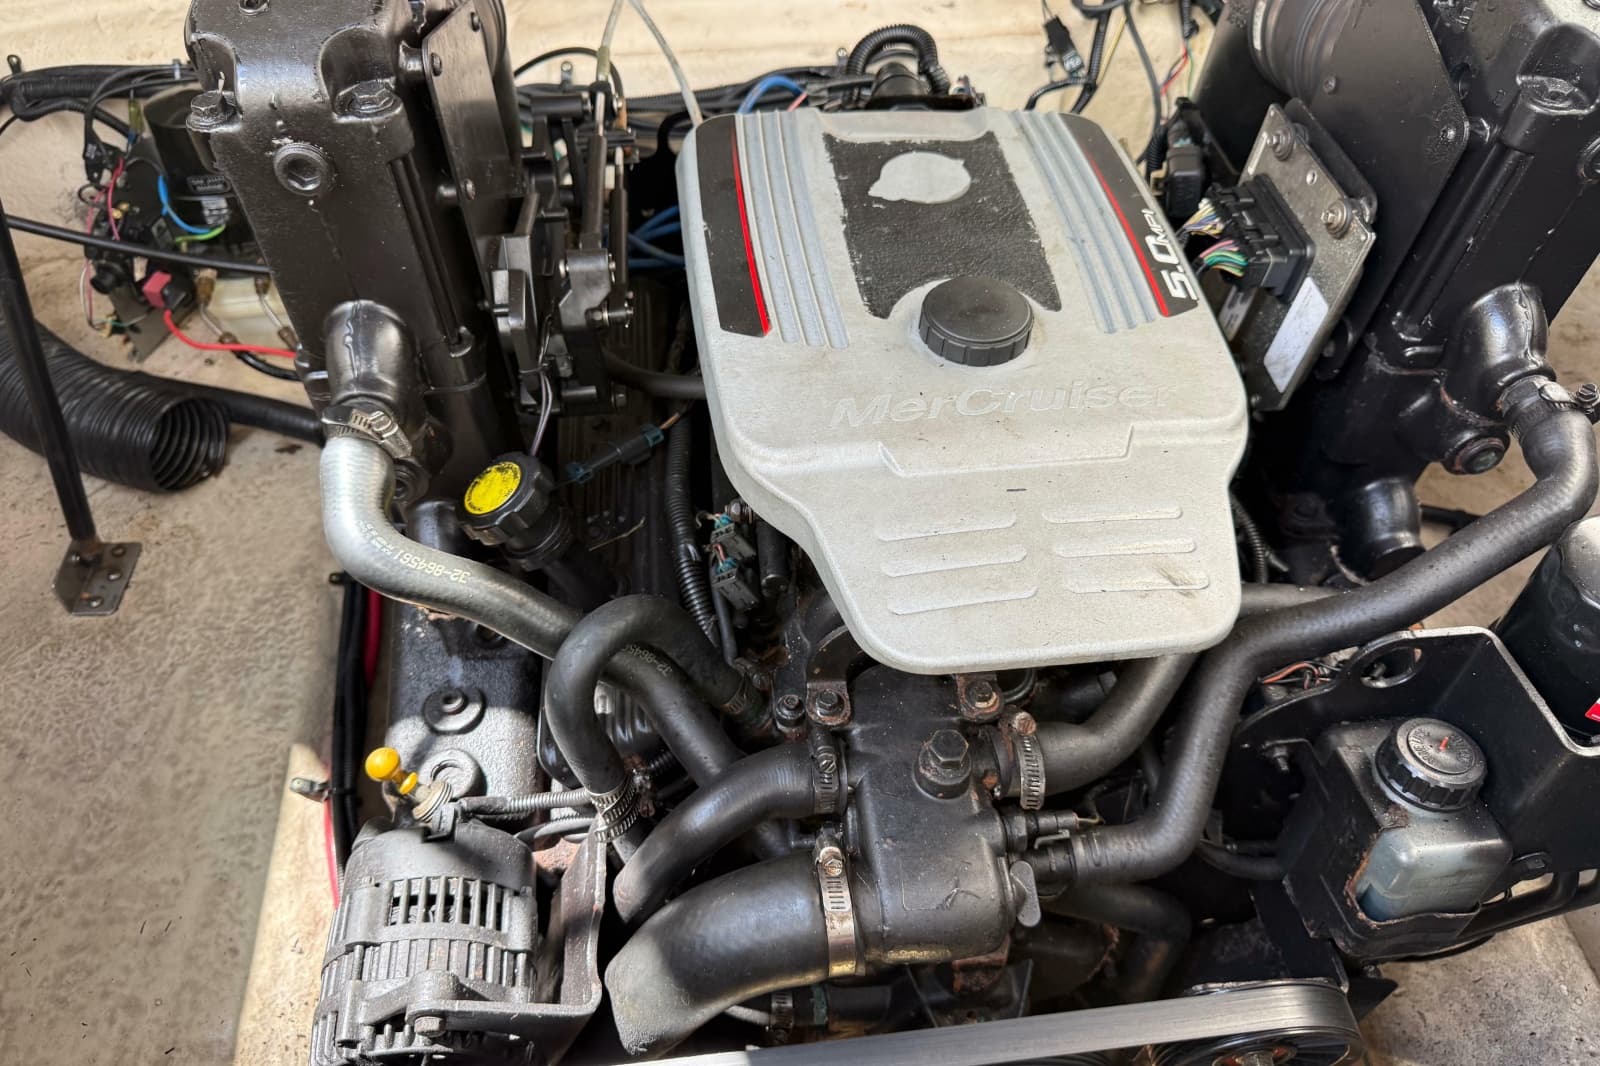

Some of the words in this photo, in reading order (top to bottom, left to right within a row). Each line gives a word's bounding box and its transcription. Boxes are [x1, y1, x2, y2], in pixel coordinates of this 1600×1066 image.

[1141, 208, 1169, 245] MPI
[1145, 234, 1199, 301] 5.0
[828, 380, 1175, 430] MerCruiser
